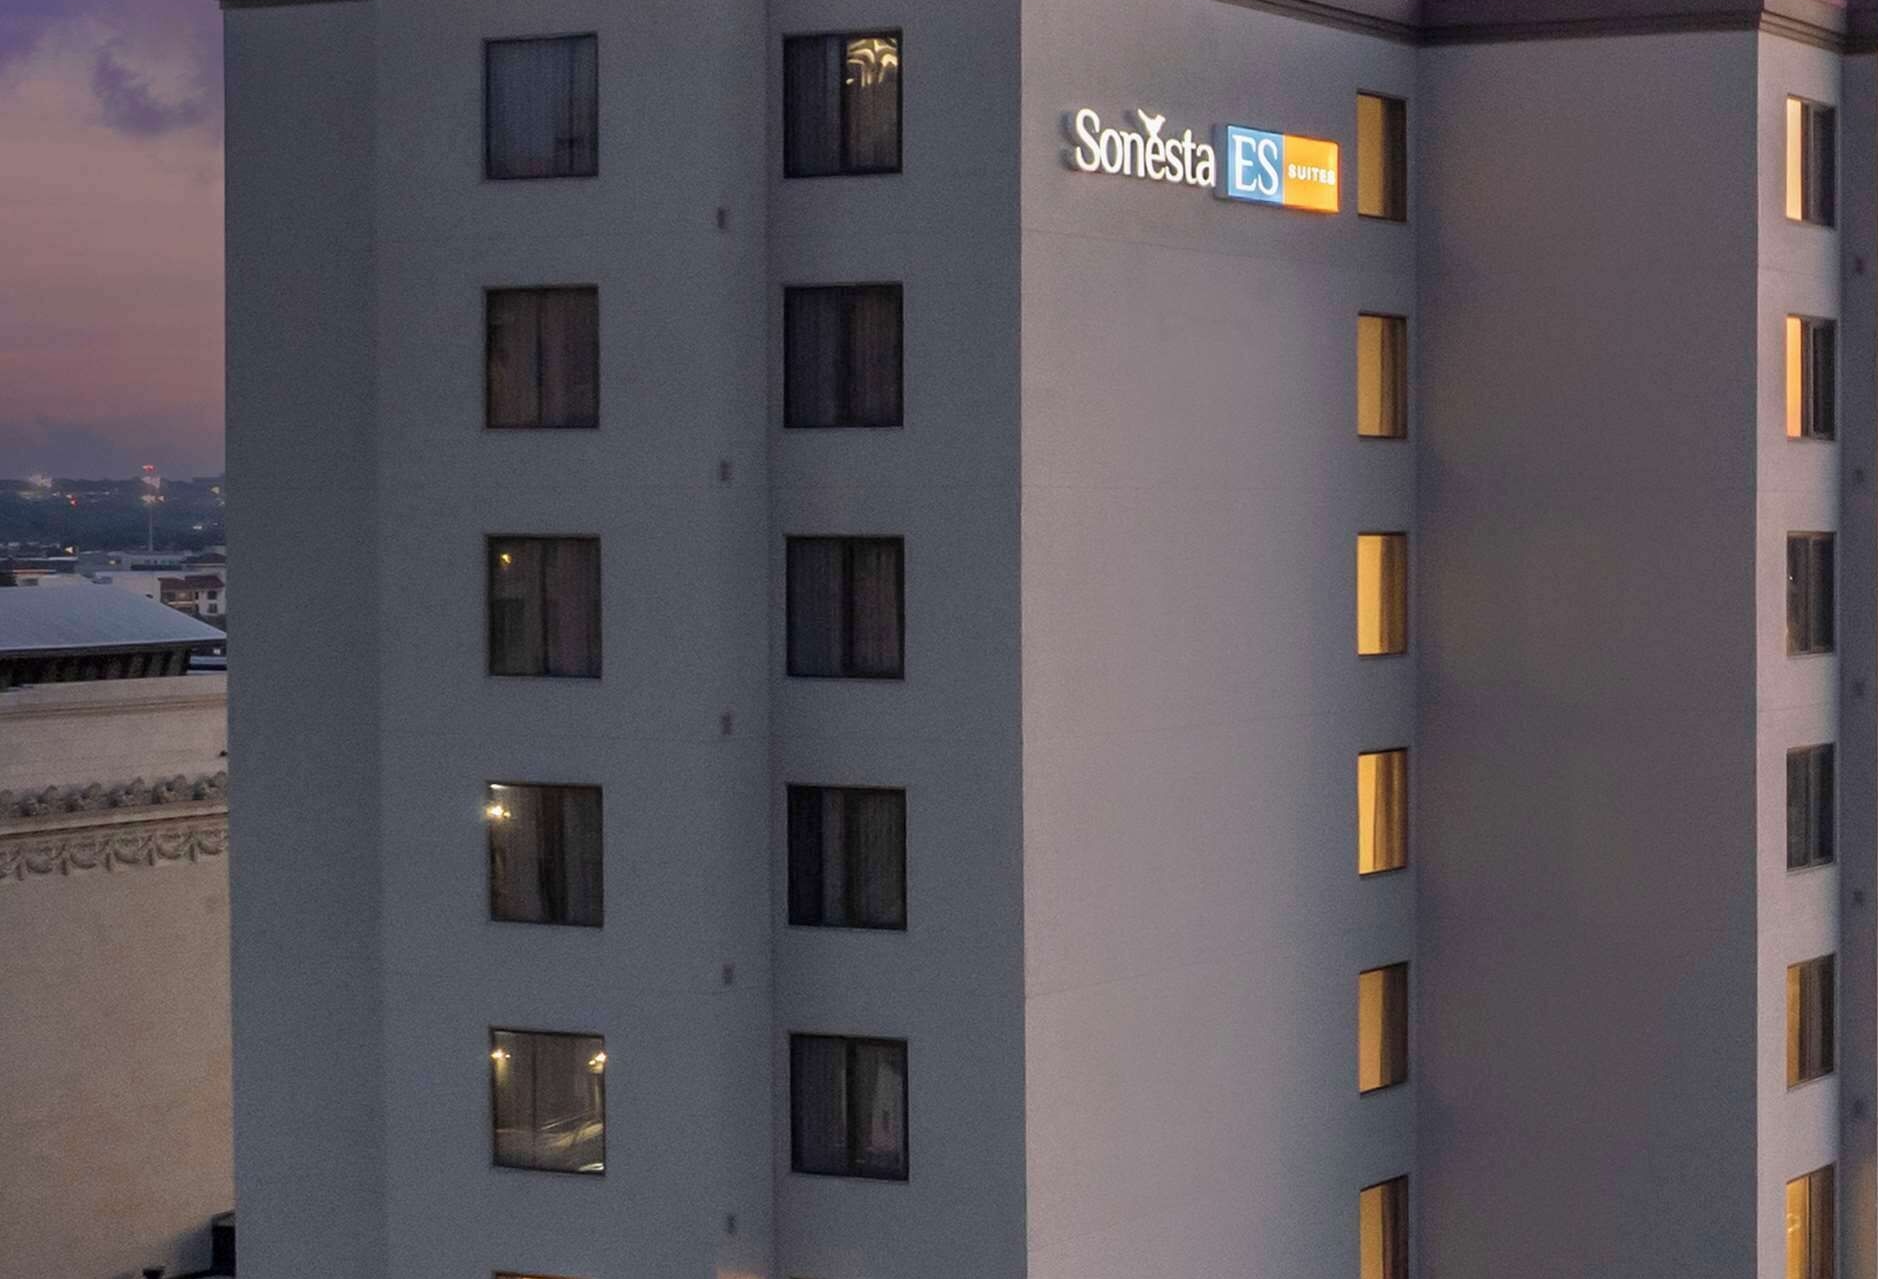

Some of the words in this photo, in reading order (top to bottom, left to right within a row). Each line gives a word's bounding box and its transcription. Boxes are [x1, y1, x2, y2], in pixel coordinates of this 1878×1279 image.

[1075, 108, 1216, 187] Sonesta
[1231, 134, 1279, 195] ES
[1287, 164, 1336, 186] SUITES
